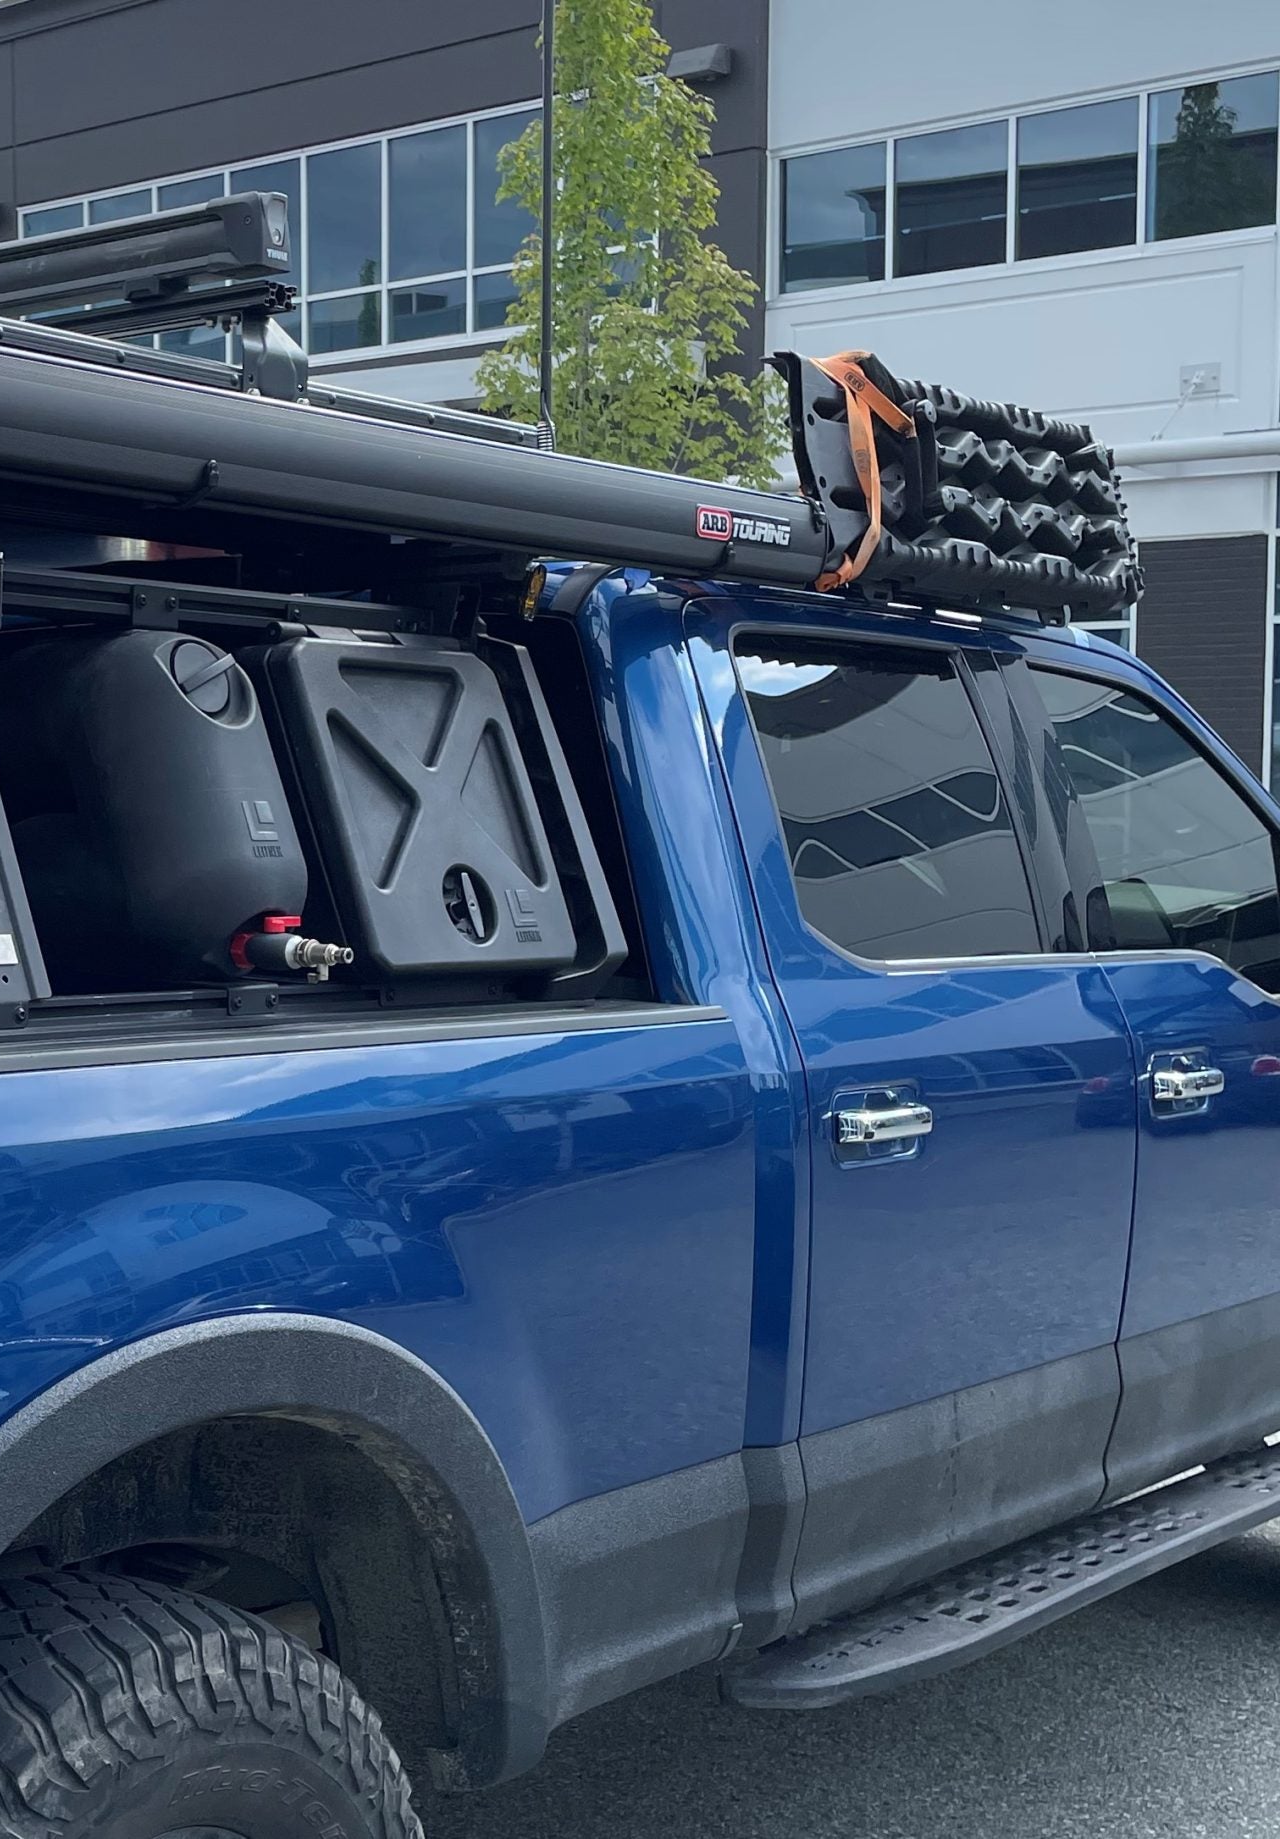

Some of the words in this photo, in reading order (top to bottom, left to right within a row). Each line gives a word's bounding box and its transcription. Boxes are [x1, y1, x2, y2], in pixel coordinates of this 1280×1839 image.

[266, 247, 288, 262] THULE
[702, 513, 728, 533] ARB
[733, 517, 791, 546] TOURING
